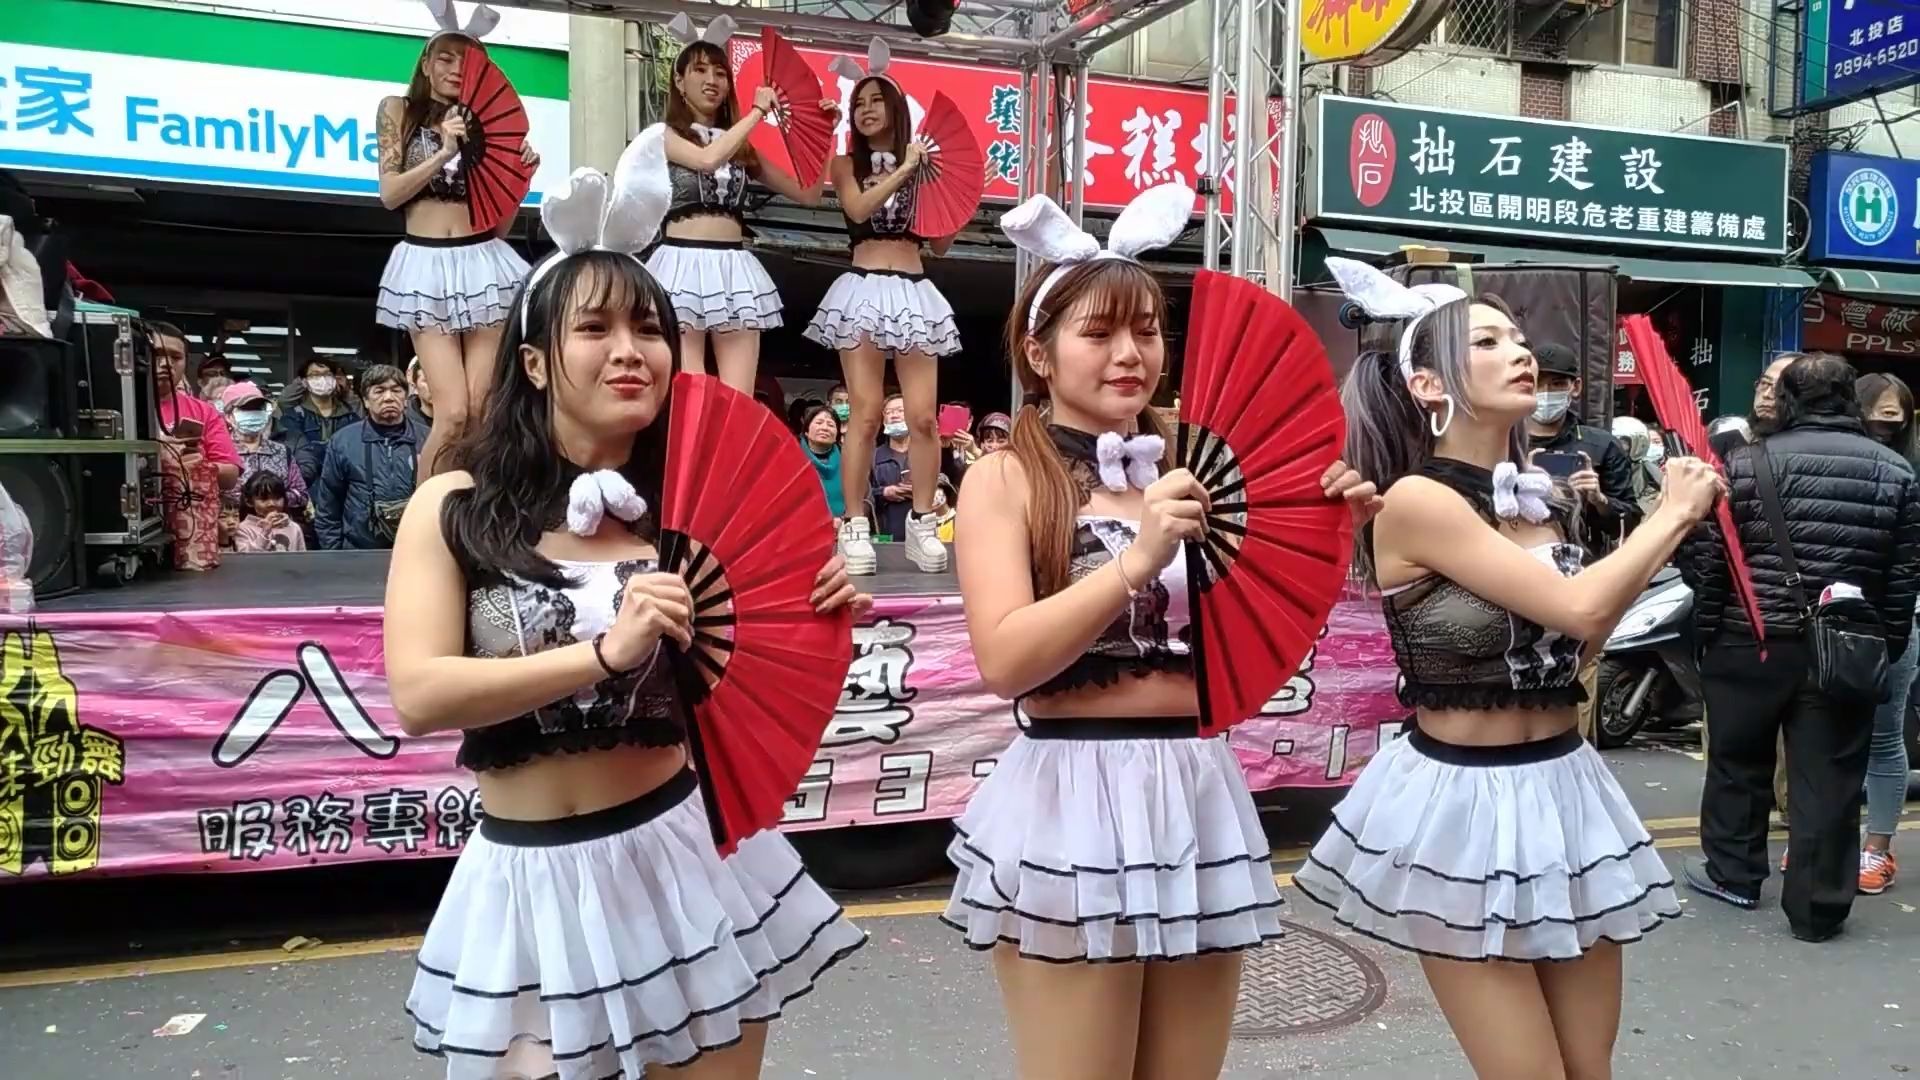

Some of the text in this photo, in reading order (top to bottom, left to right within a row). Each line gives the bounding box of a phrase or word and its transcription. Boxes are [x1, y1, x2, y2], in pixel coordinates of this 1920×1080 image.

[1834, 38, 1919, 79] 2894-6520
[1849, 15, 1904, 46] 北投店
[0, 66, 94, 137] 家
[1410, 121, 1665, 194] 拙石建設
[1409, 185, 1766, 241] 北投區開明段危老重建籌備處
